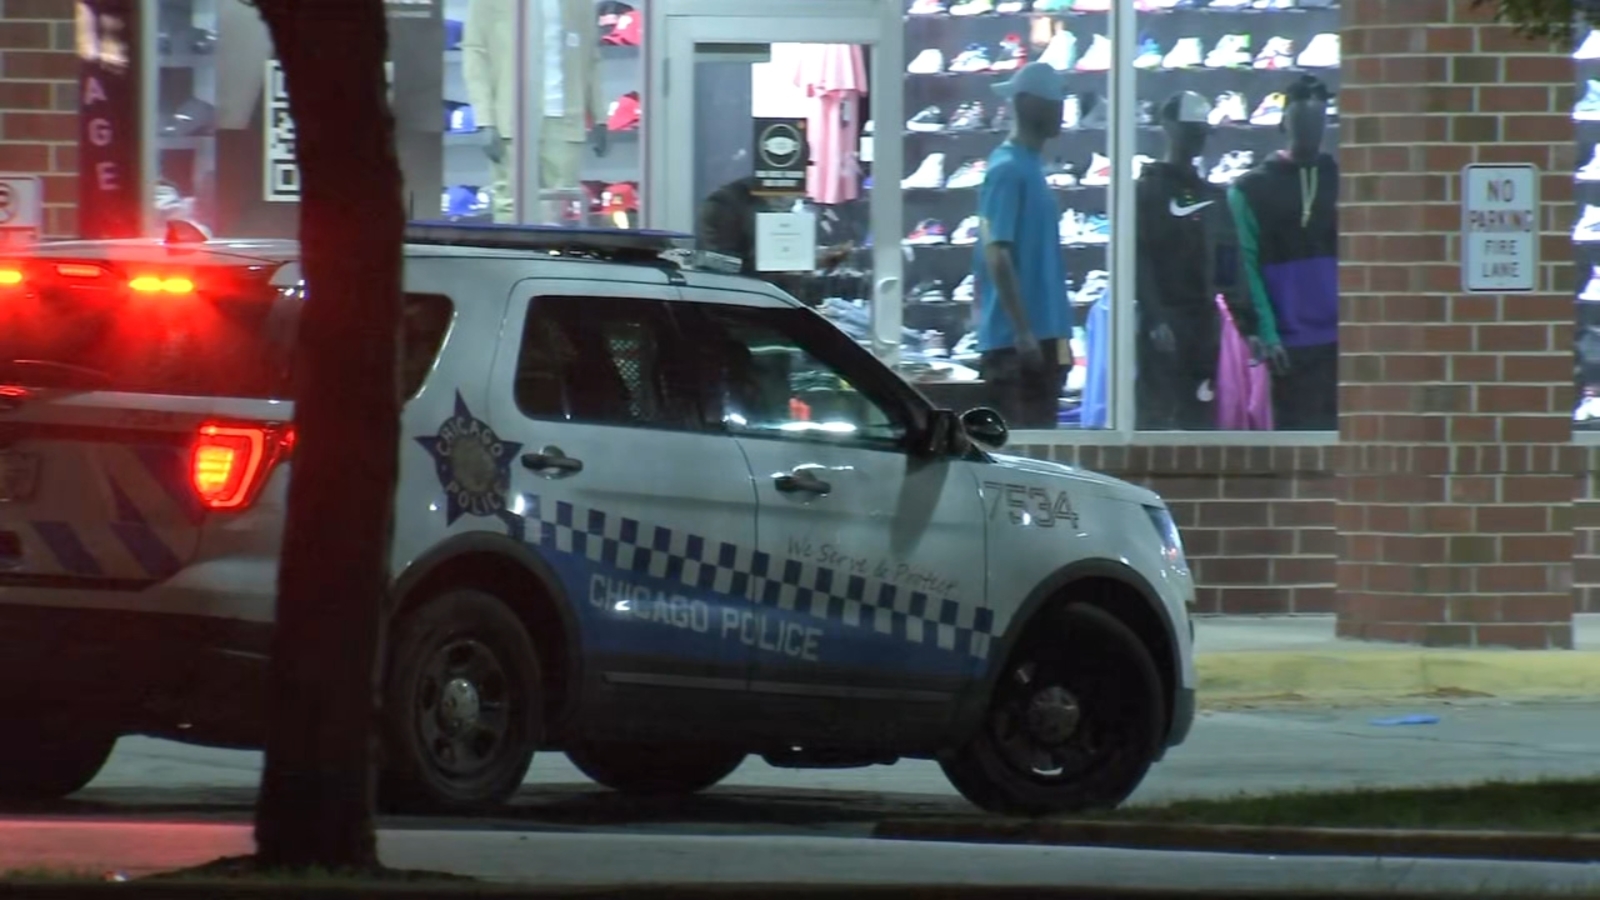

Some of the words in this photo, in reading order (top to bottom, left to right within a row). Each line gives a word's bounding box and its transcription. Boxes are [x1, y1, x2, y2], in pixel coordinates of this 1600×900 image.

[1486, 179, 1515, 202] NO
[1469, 209, 1534, 232] PARKING
[1485, 239, 1518, 255] FIRE
[1482, 261, 1520, 277] LANE
[436, 416, 504, 457] CHICAGO
[983, 480, 1080, 529] 7534
[816, 542, 868, 573] Serve
[588, 573, 709, 633] CHICAGO
[720, 606, 824, 662] POLICE
